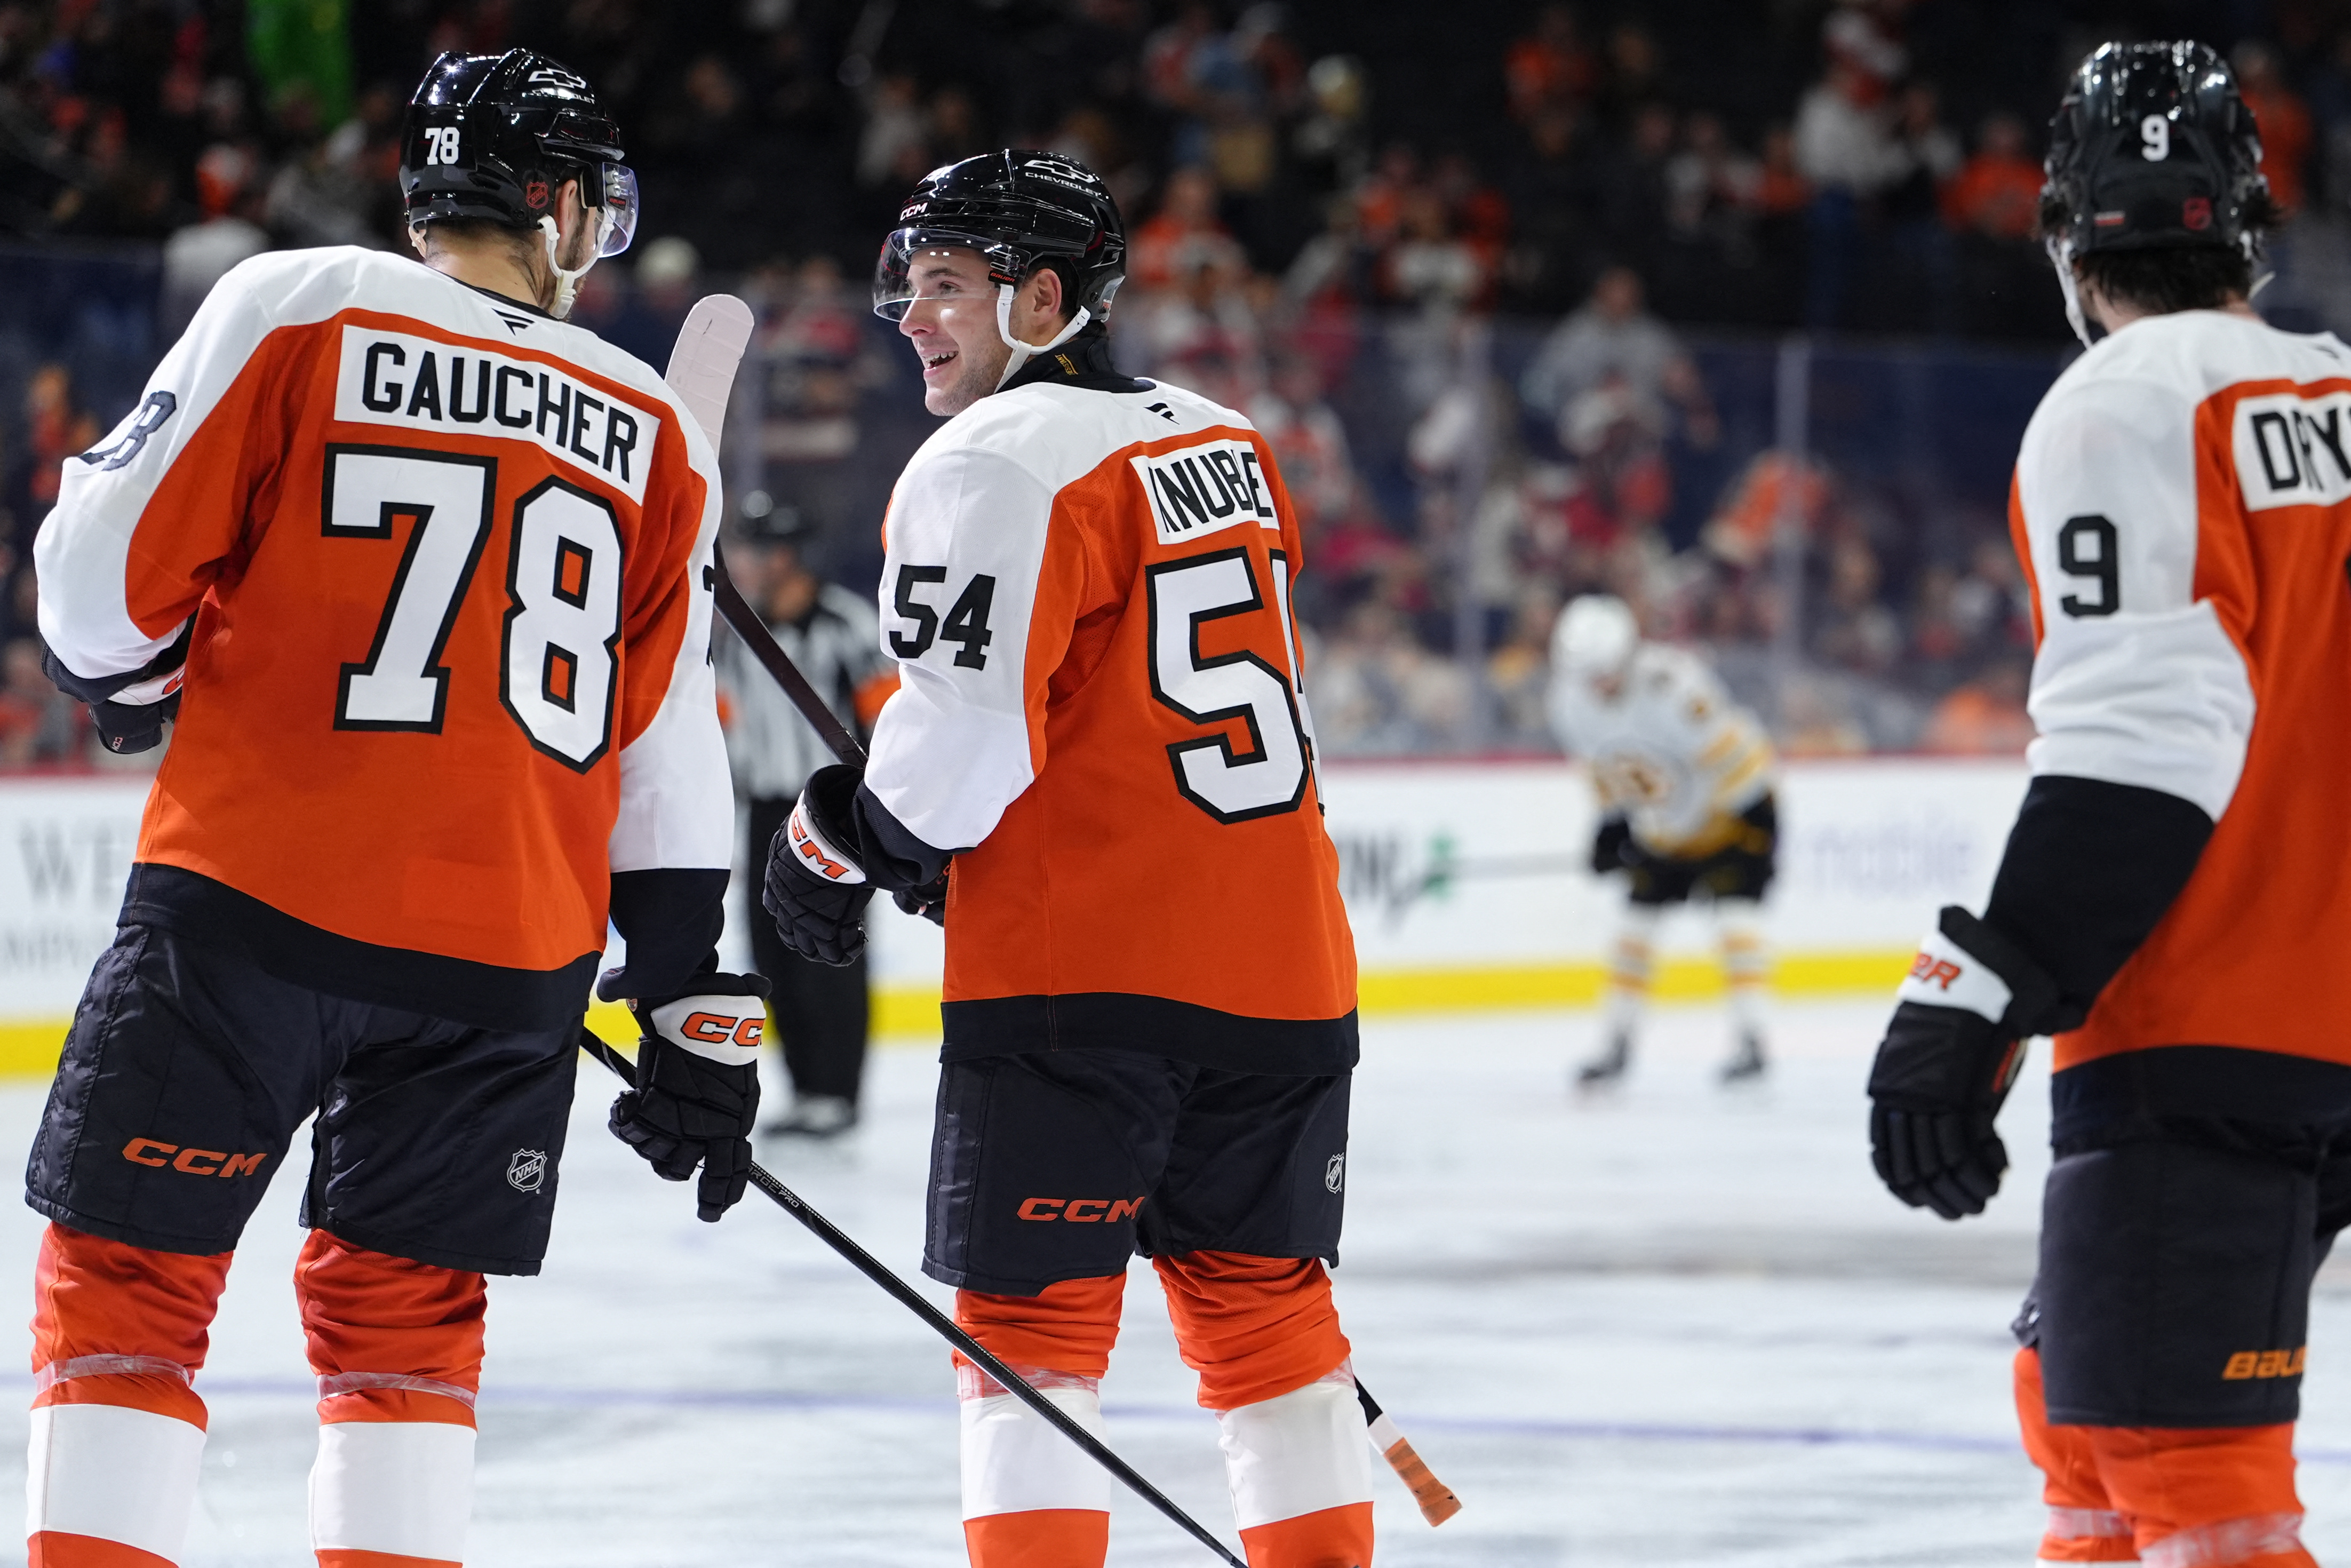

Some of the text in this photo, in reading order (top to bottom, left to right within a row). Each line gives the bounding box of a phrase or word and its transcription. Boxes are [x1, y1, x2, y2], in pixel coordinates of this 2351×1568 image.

[425, 128, 460, 165] 78
[2141, 114, 2170, 162] 9
[1025, 172, 1102, 197] CHEVROLET
[900, 202, 928, 221] CCM
[990, 273, 1015, 282] BAUER
[362, 341, 639, 483] GAUCHER
[2059, 512, 2121, 620] 9
[321, 442, 625, 775] 78
[889, 564, 996, 671] 54
[111, 737, 123, 751] CCM
[680, 1012, 766, 1047] CC
[122, 1137, 267, 1178] CCM
[515, 1161, 539, 1181] NHL
[778, 1190, 800, 1208] PRO
[1016, 1196, 1145, 1223] CCM
